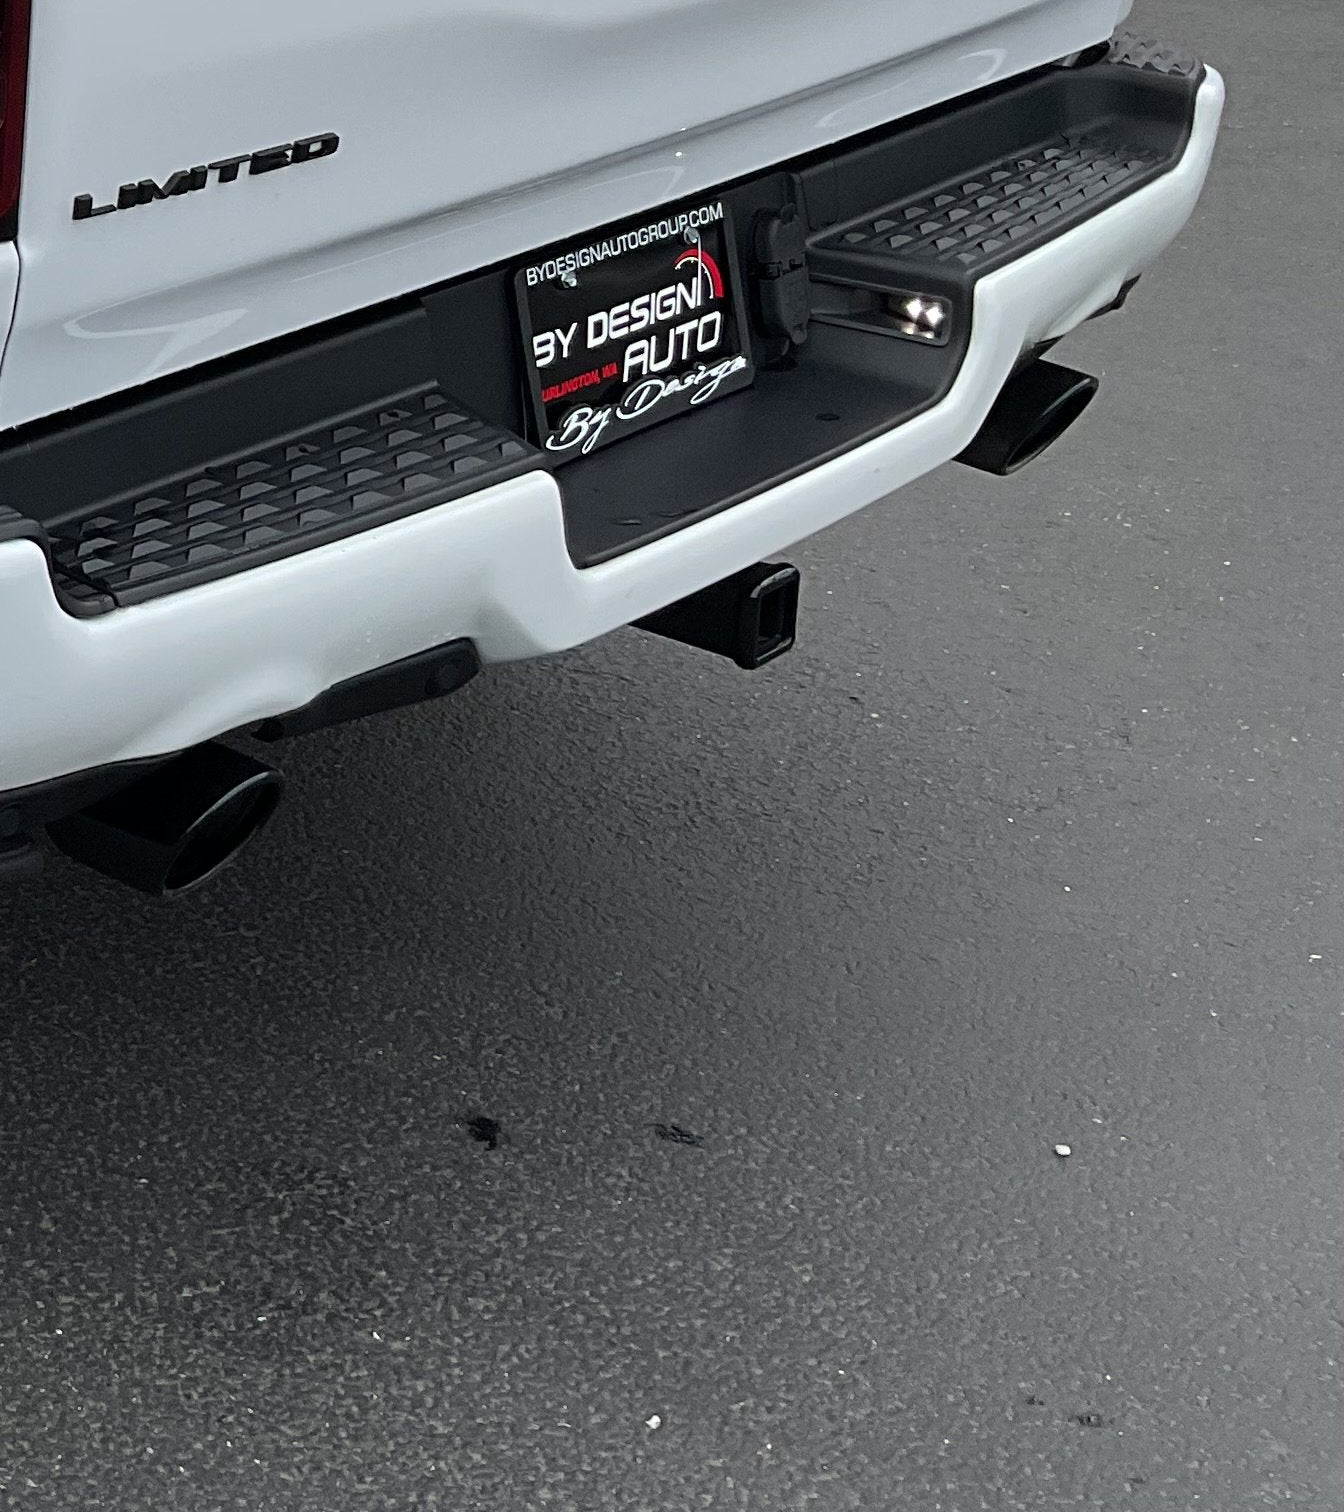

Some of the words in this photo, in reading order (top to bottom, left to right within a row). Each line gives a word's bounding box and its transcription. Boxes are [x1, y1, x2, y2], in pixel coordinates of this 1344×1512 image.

[71, 132, 340, 220] LIMITED
[532, 323, 578, 368] BY
[587, 277, 699, 349] DESIGN
[622, 311, 722, 383] AUTO
[545, 406, 612, 455] By
[615, 355, 748, 421] Design
